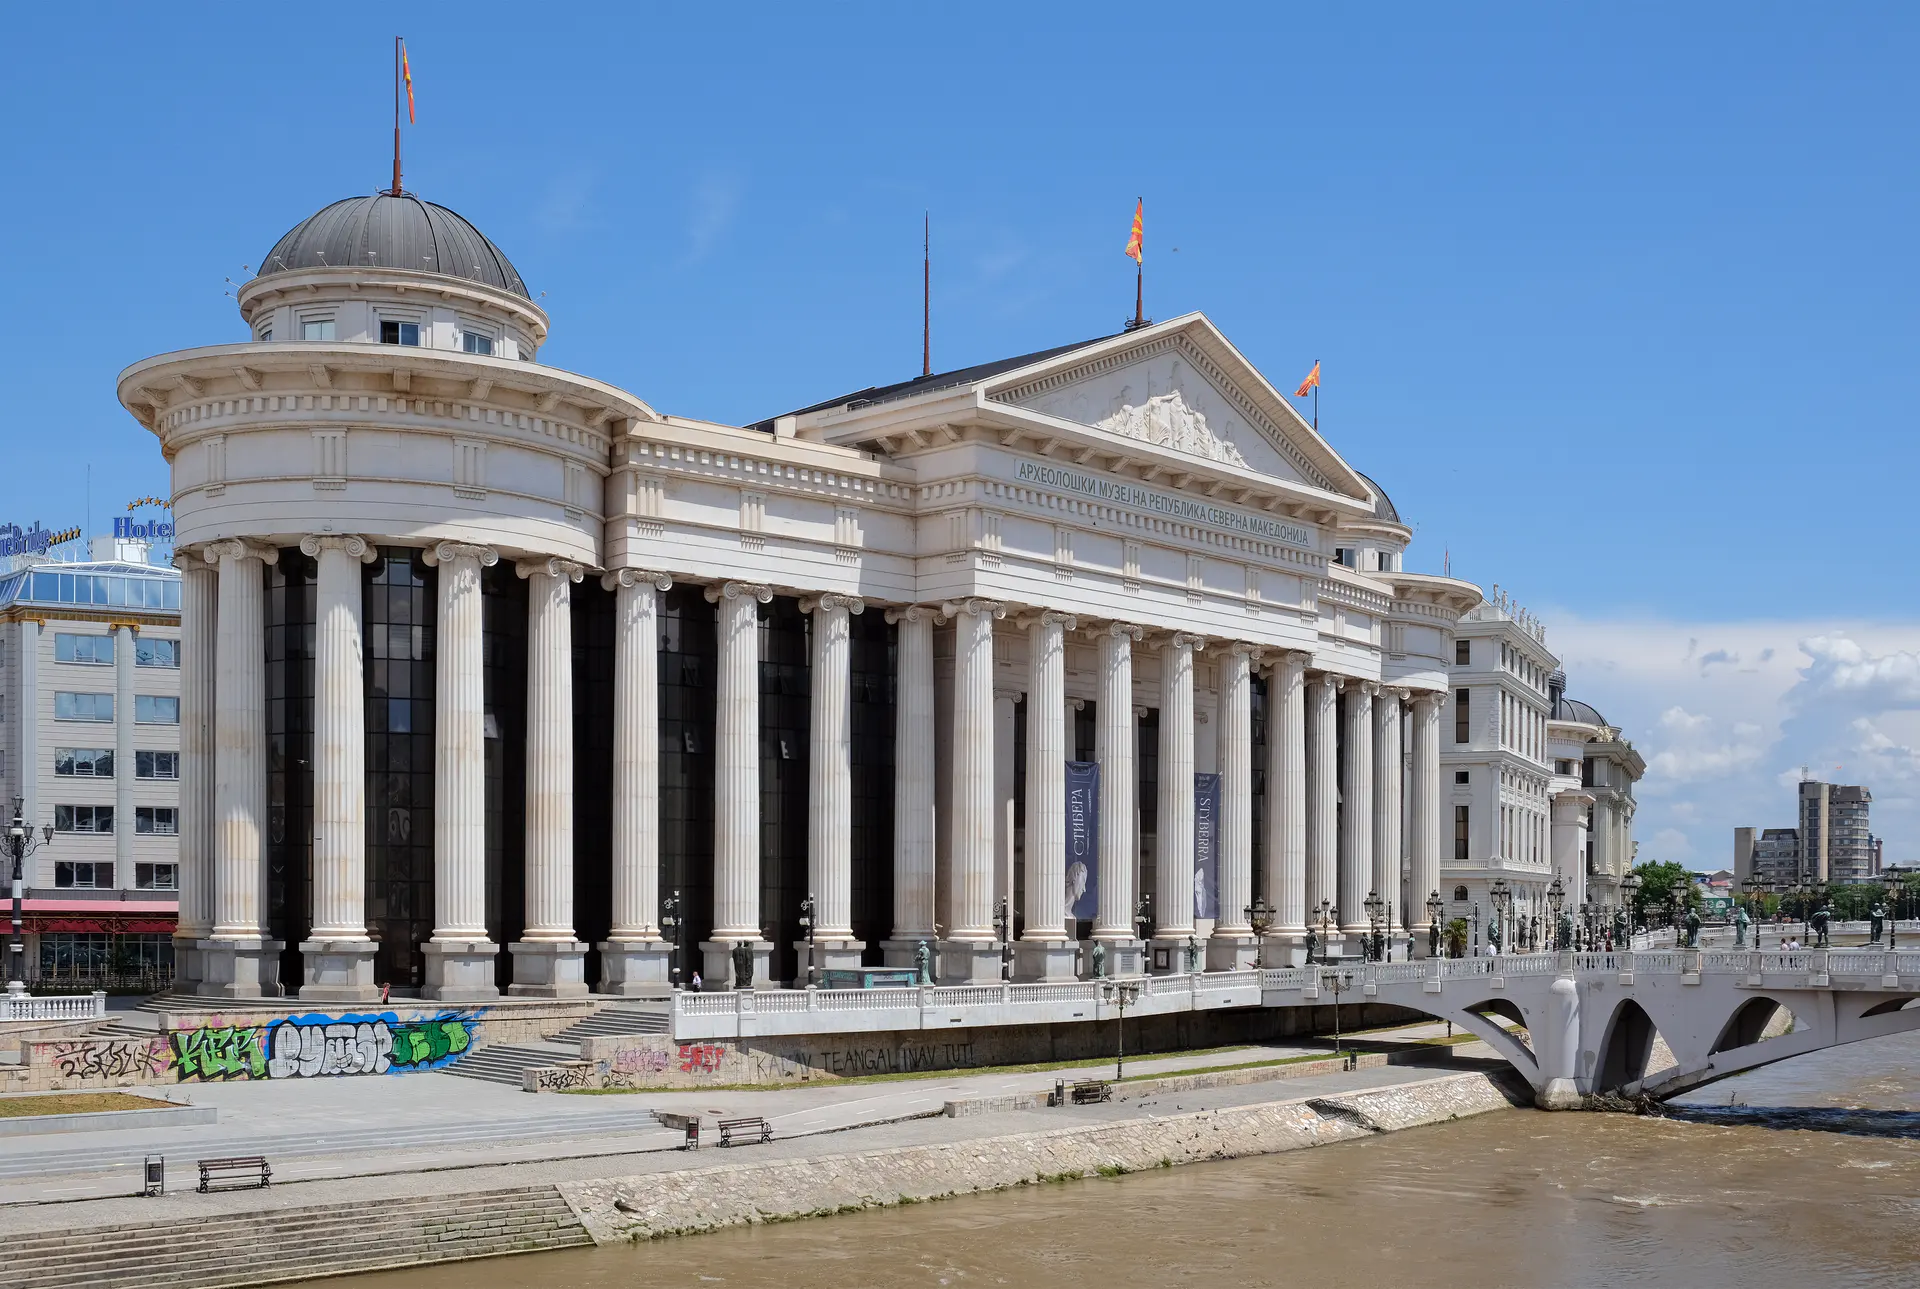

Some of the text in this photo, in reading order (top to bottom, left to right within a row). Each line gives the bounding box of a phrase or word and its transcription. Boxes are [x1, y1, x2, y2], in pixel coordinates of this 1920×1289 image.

[1019, 462, 1309, 544] АРХЕОЛОШКИ МУЗЕЈ НА РЕПУБЛИКА СЕВЕРНА МАКЕДОНИЈА
[1071, 788, 1085, 856] СТИБЕРА
[1198, 797, 1211, 862] STYBERRA
